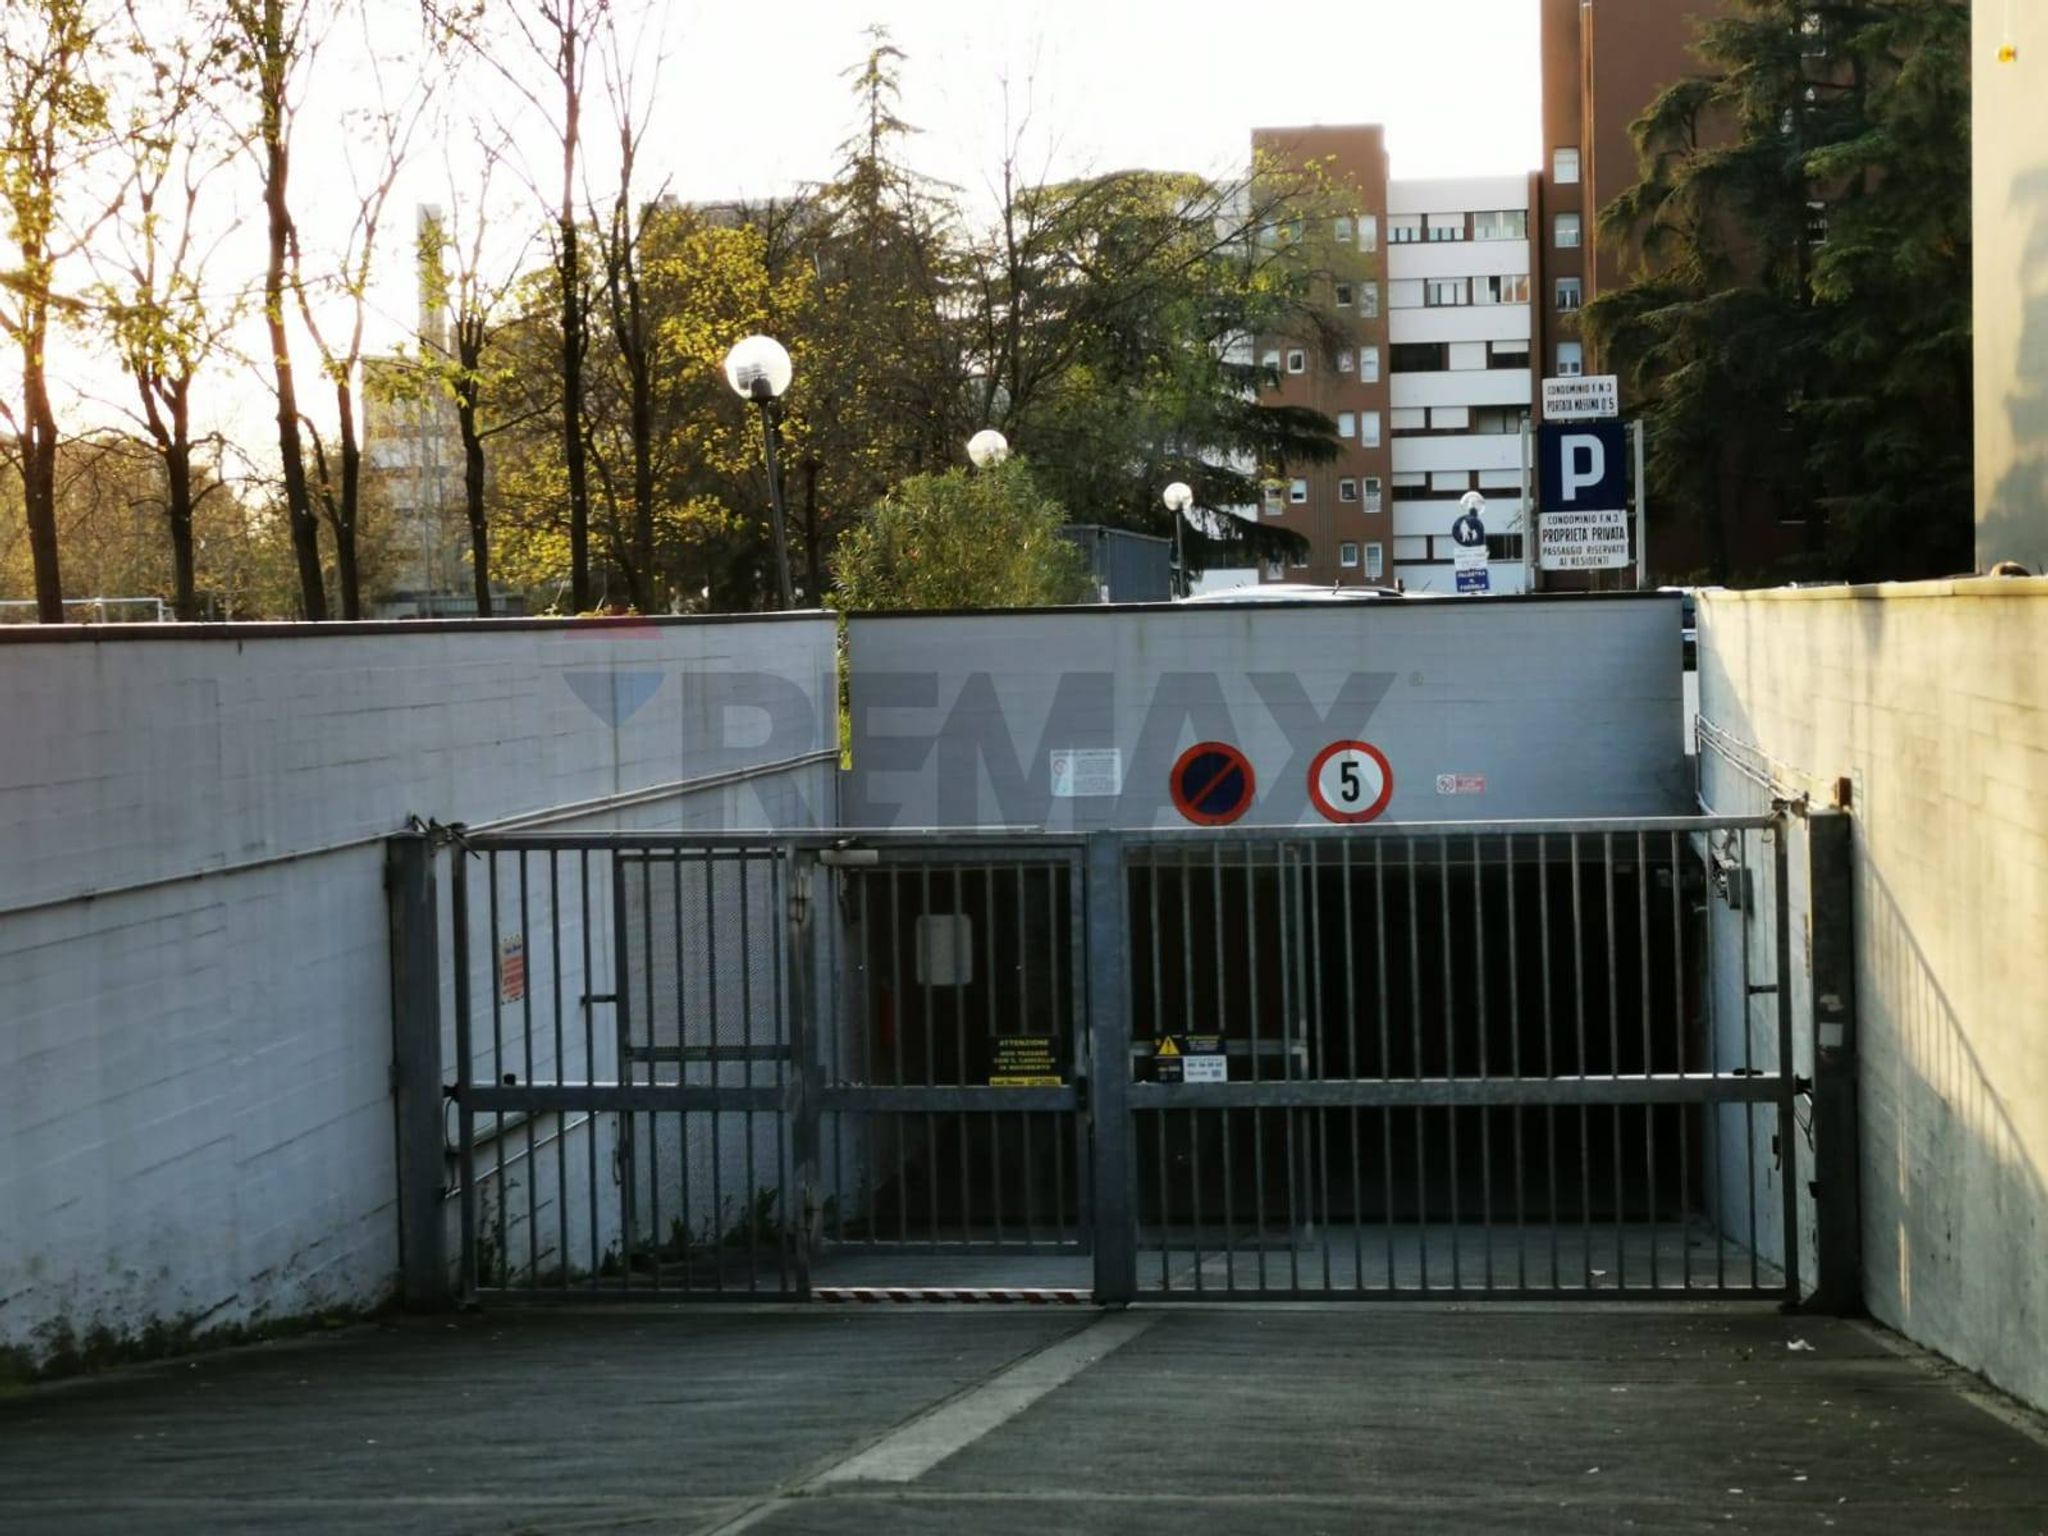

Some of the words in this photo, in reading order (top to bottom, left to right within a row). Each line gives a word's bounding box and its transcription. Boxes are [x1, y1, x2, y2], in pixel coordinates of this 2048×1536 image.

[1547, 384, 1590, 395] CONDOMINIO
[1547, 399, 1573, 413] PORTATA
[1574, 398, 1599, 411] MASSIMA
[1560, 433, 1605, 501] P
[1548, 514, 1597, 525] CONDOMINIO
[1592, 525, 1625, 542] PRIVATA
[1542, 545, 1583, 556] PASSAGGIO
[1586, 543, 1625, 555] RISERVATO
[1570, 555, 1609, 566] RESIDENTI
[1341, 762, 1360, 802] 5
